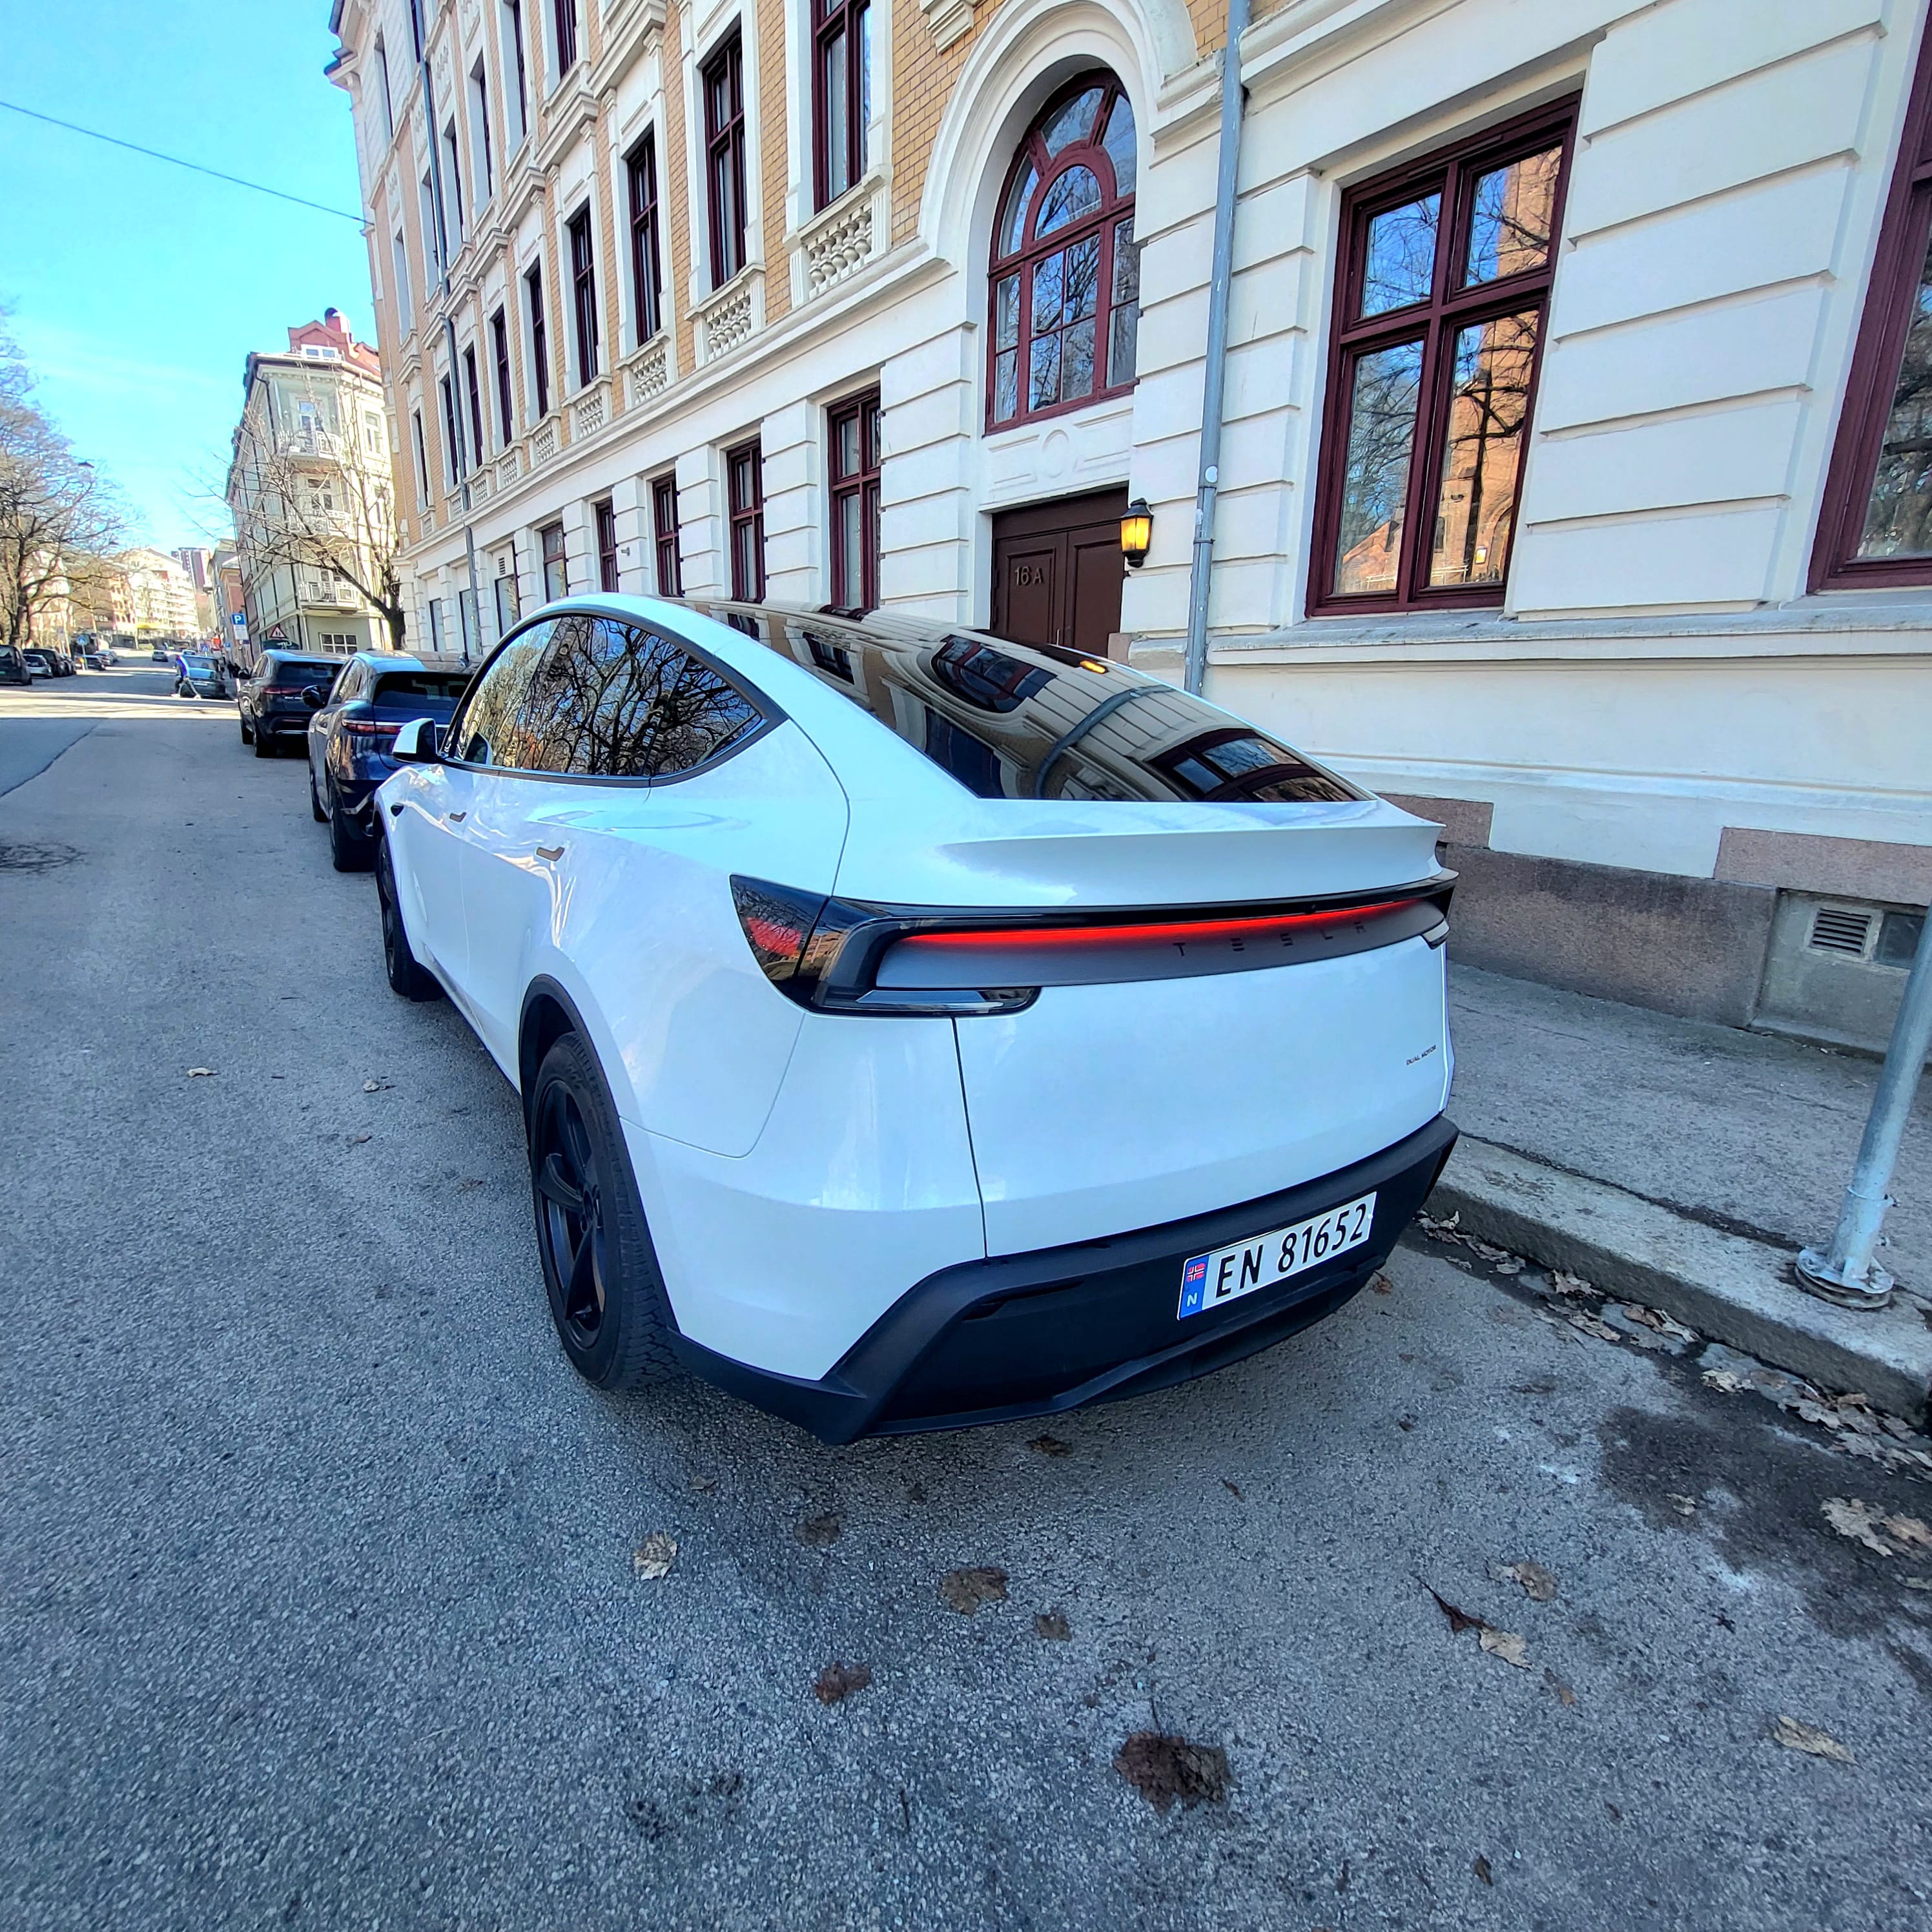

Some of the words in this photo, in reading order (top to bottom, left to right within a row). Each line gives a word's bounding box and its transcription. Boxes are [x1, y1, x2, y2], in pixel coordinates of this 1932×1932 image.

[1014, 566, 1030, 586] 16
[1033, 567, 1042, 584] A
[234, 615, 242, 624] P
[1173, 921, 1367, 956] TESLA
[1215, 1244, 1264, 1299] EN
[1277, 1203, 1367, 1273] 81652
[1187, 1292, 1198, 1307] N
